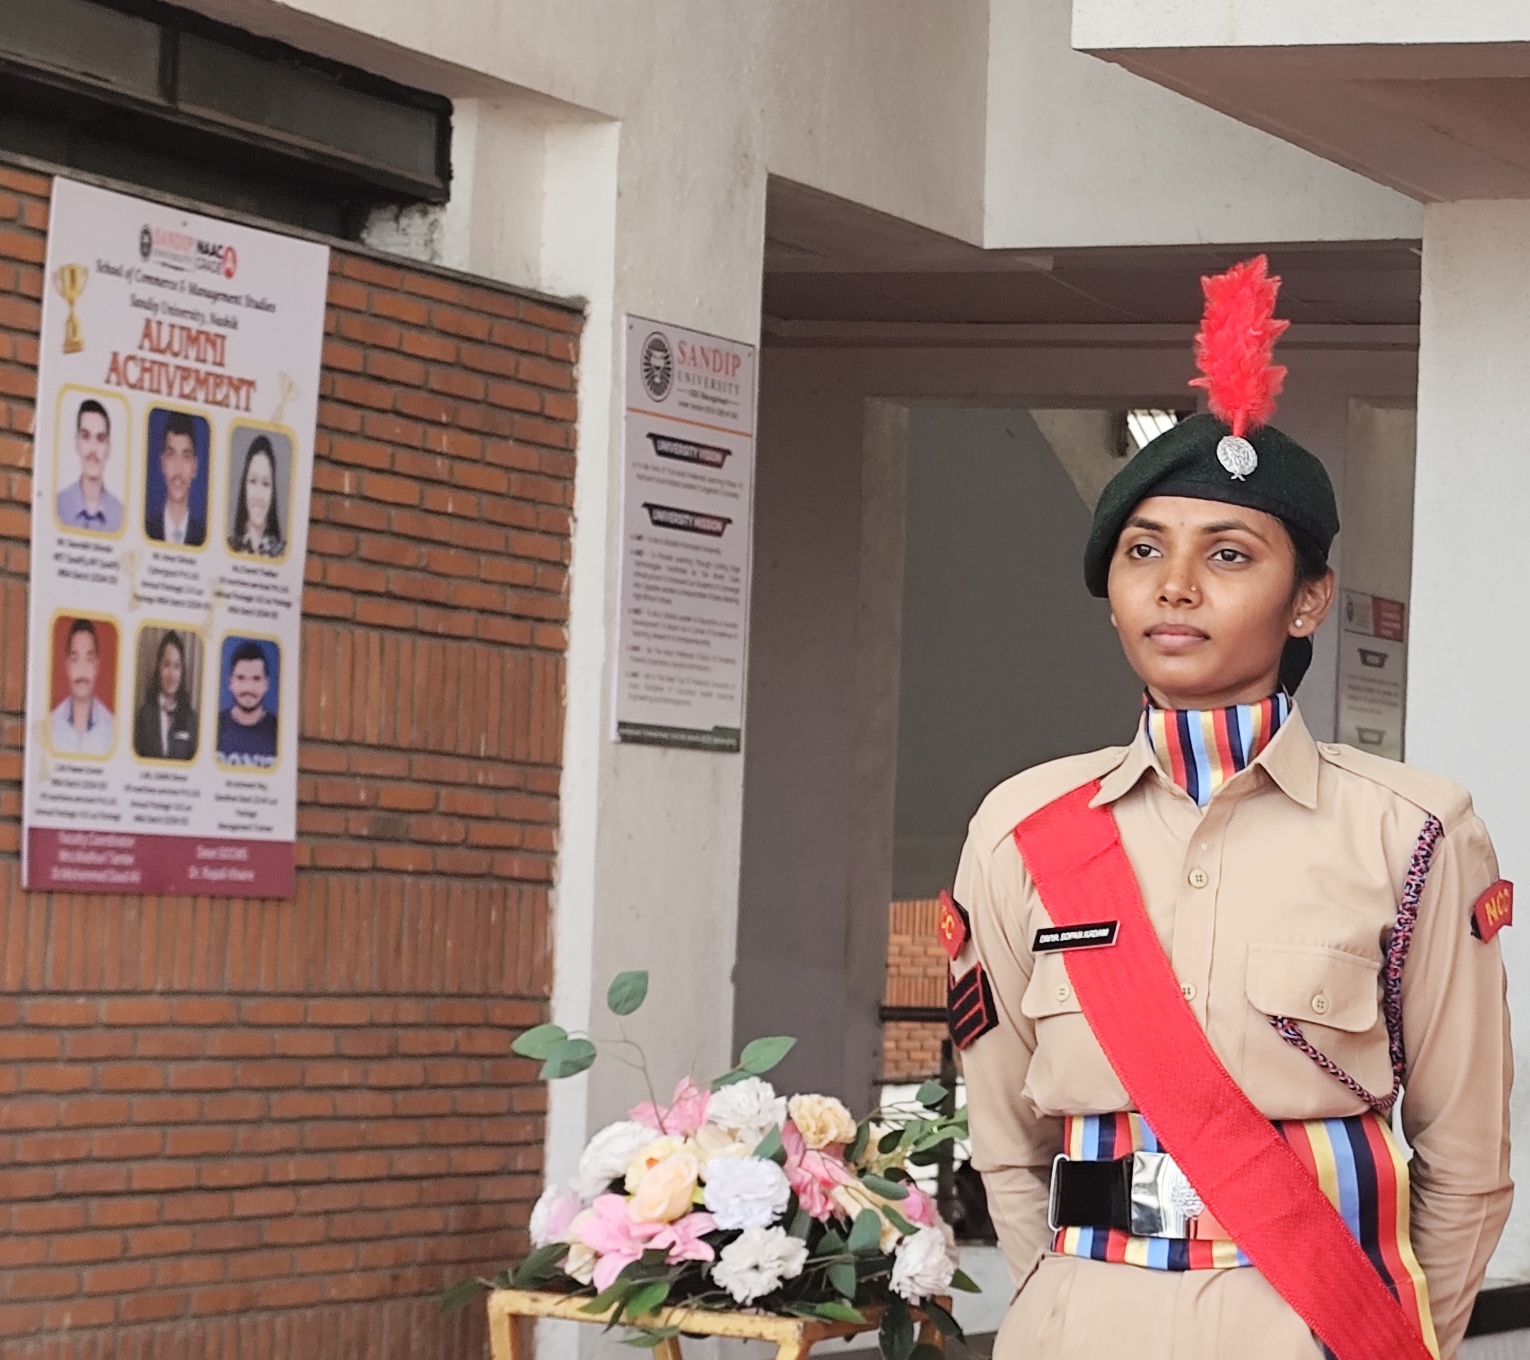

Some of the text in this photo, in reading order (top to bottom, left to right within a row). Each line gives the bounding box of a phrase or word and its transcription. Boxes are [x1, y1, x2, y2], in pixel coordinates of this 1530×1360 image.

[138, 317, 227, 367] ALUMNI
[677, 339, 742, 378] SANDIP
[104, 351, 257, 412] ACHIVEMENT
[677, 371, 741, 396] UNIVERSITY
[1484, 888, 1509, 926] NCC
